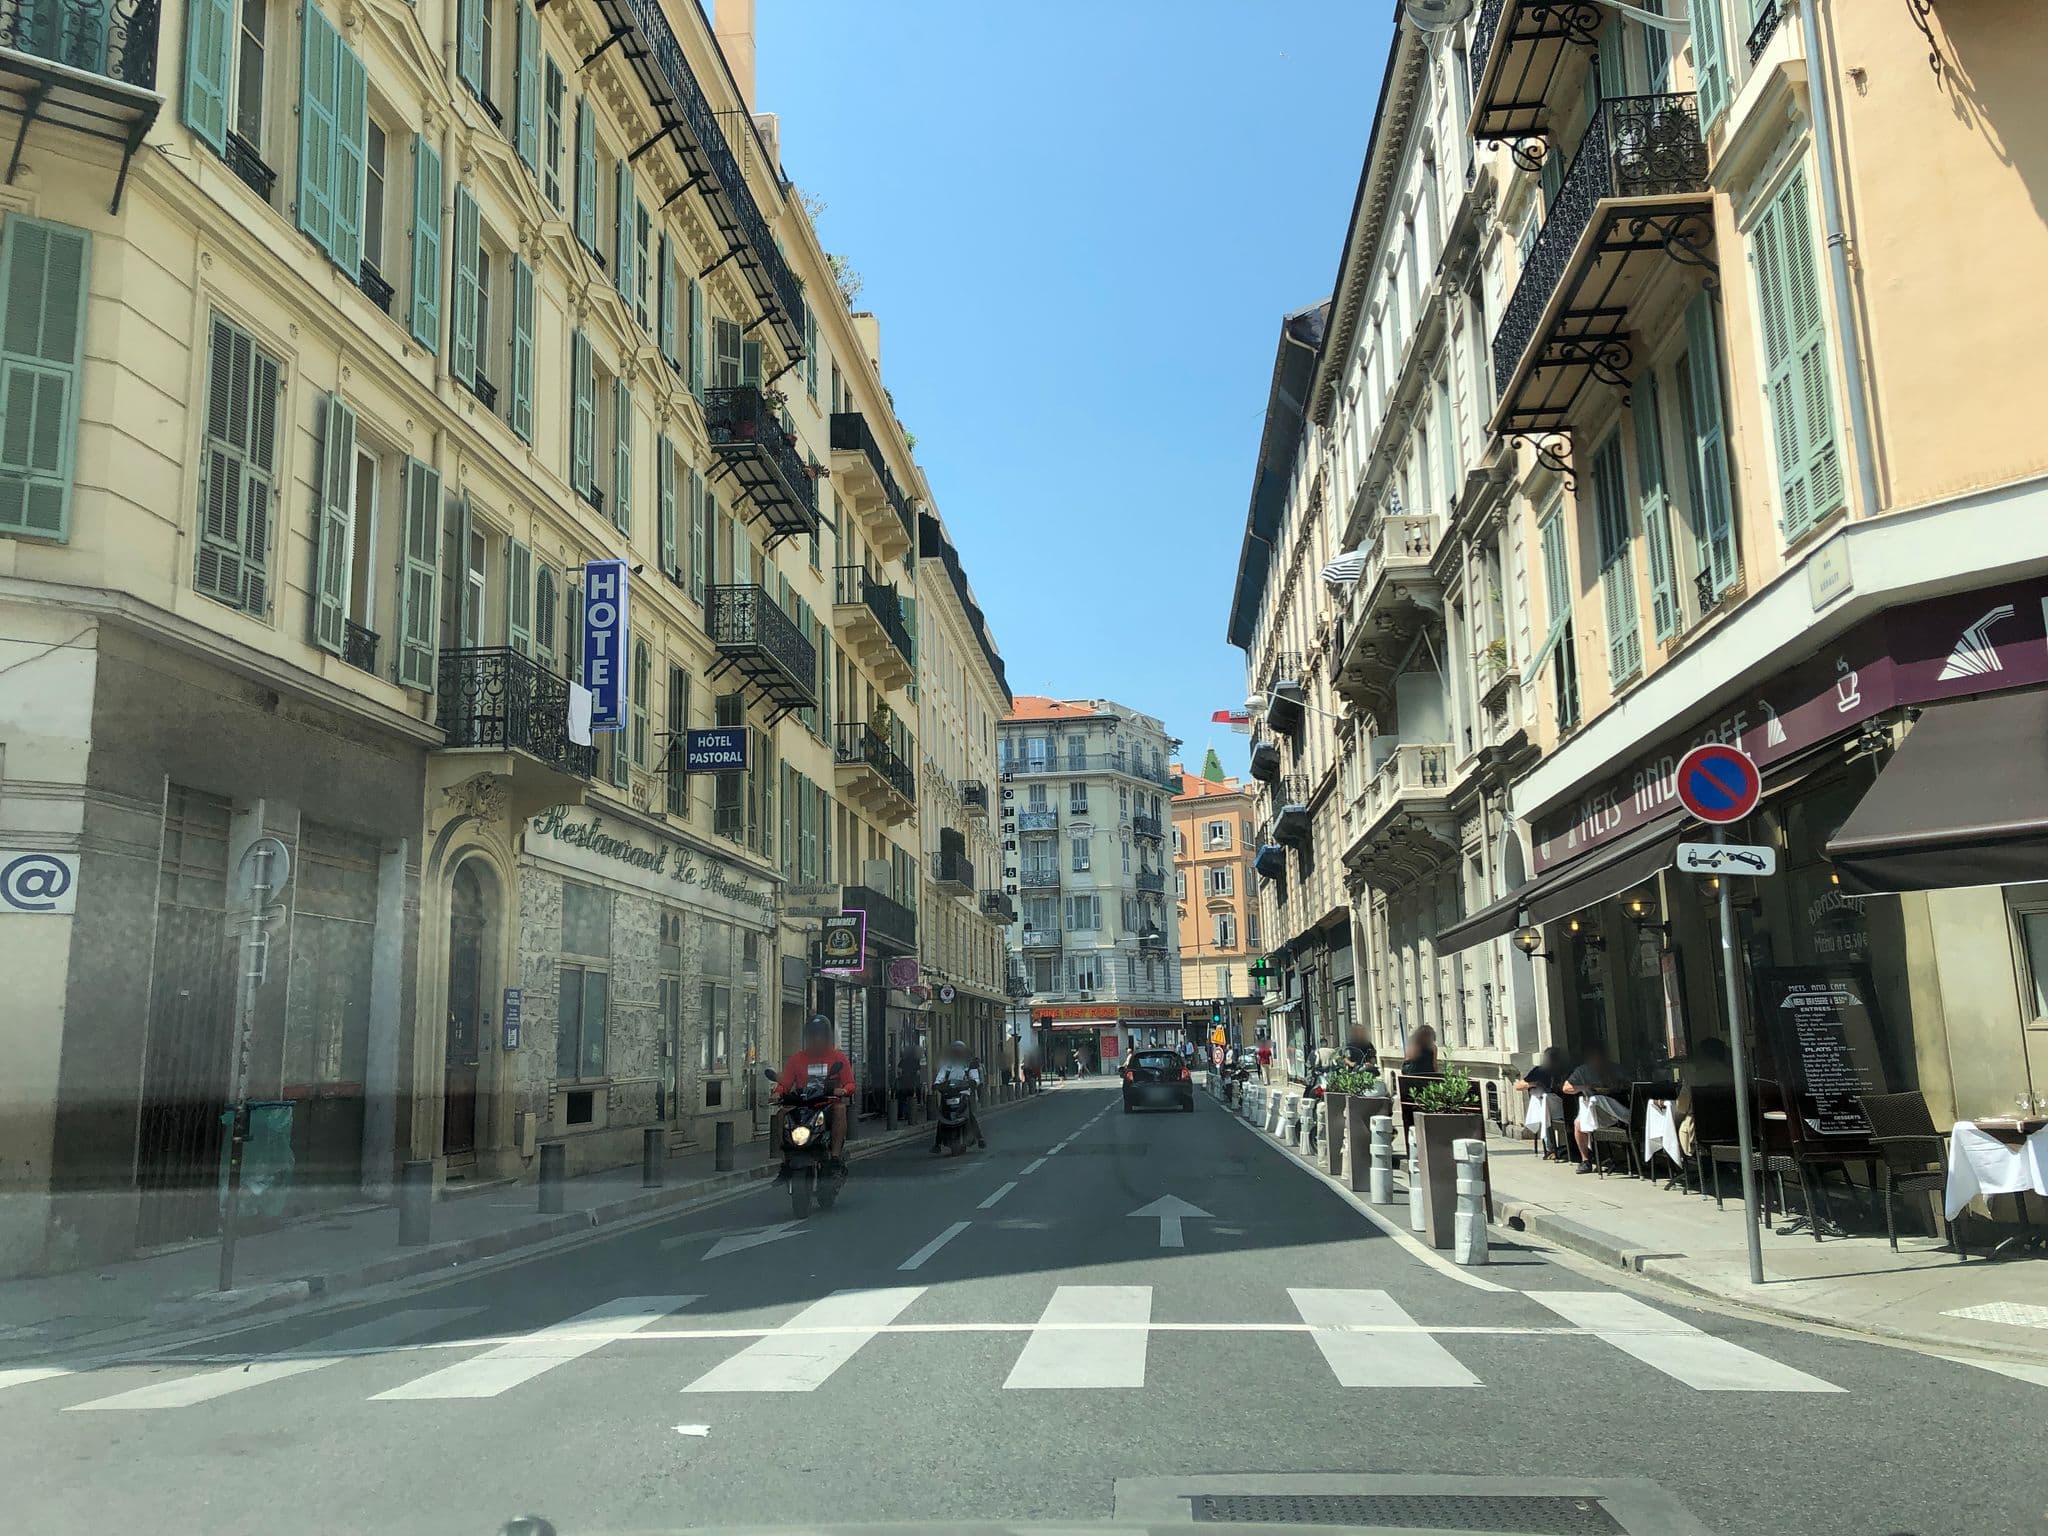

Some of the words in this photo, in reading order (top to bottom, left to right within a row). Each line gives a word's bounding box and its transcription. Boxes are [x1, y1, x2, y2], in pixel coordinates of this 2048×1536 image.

[588, 573, 616, 714] HOTEL
[689, 752, 743, 764] PASTORAL
[698, 733, 732, 747] HÔTEL
[1003, 774, 1014, 850] HOTEL
[1580, 786, 1622, 842] METS
[1633, 755, 1676, 815] AND
[533, 803, 669, 875] Restaurant
[0, 854, 71, 910] @
[826, 917, 857, 927] SUMMER
[1788, 984, 1806, 992] METS
